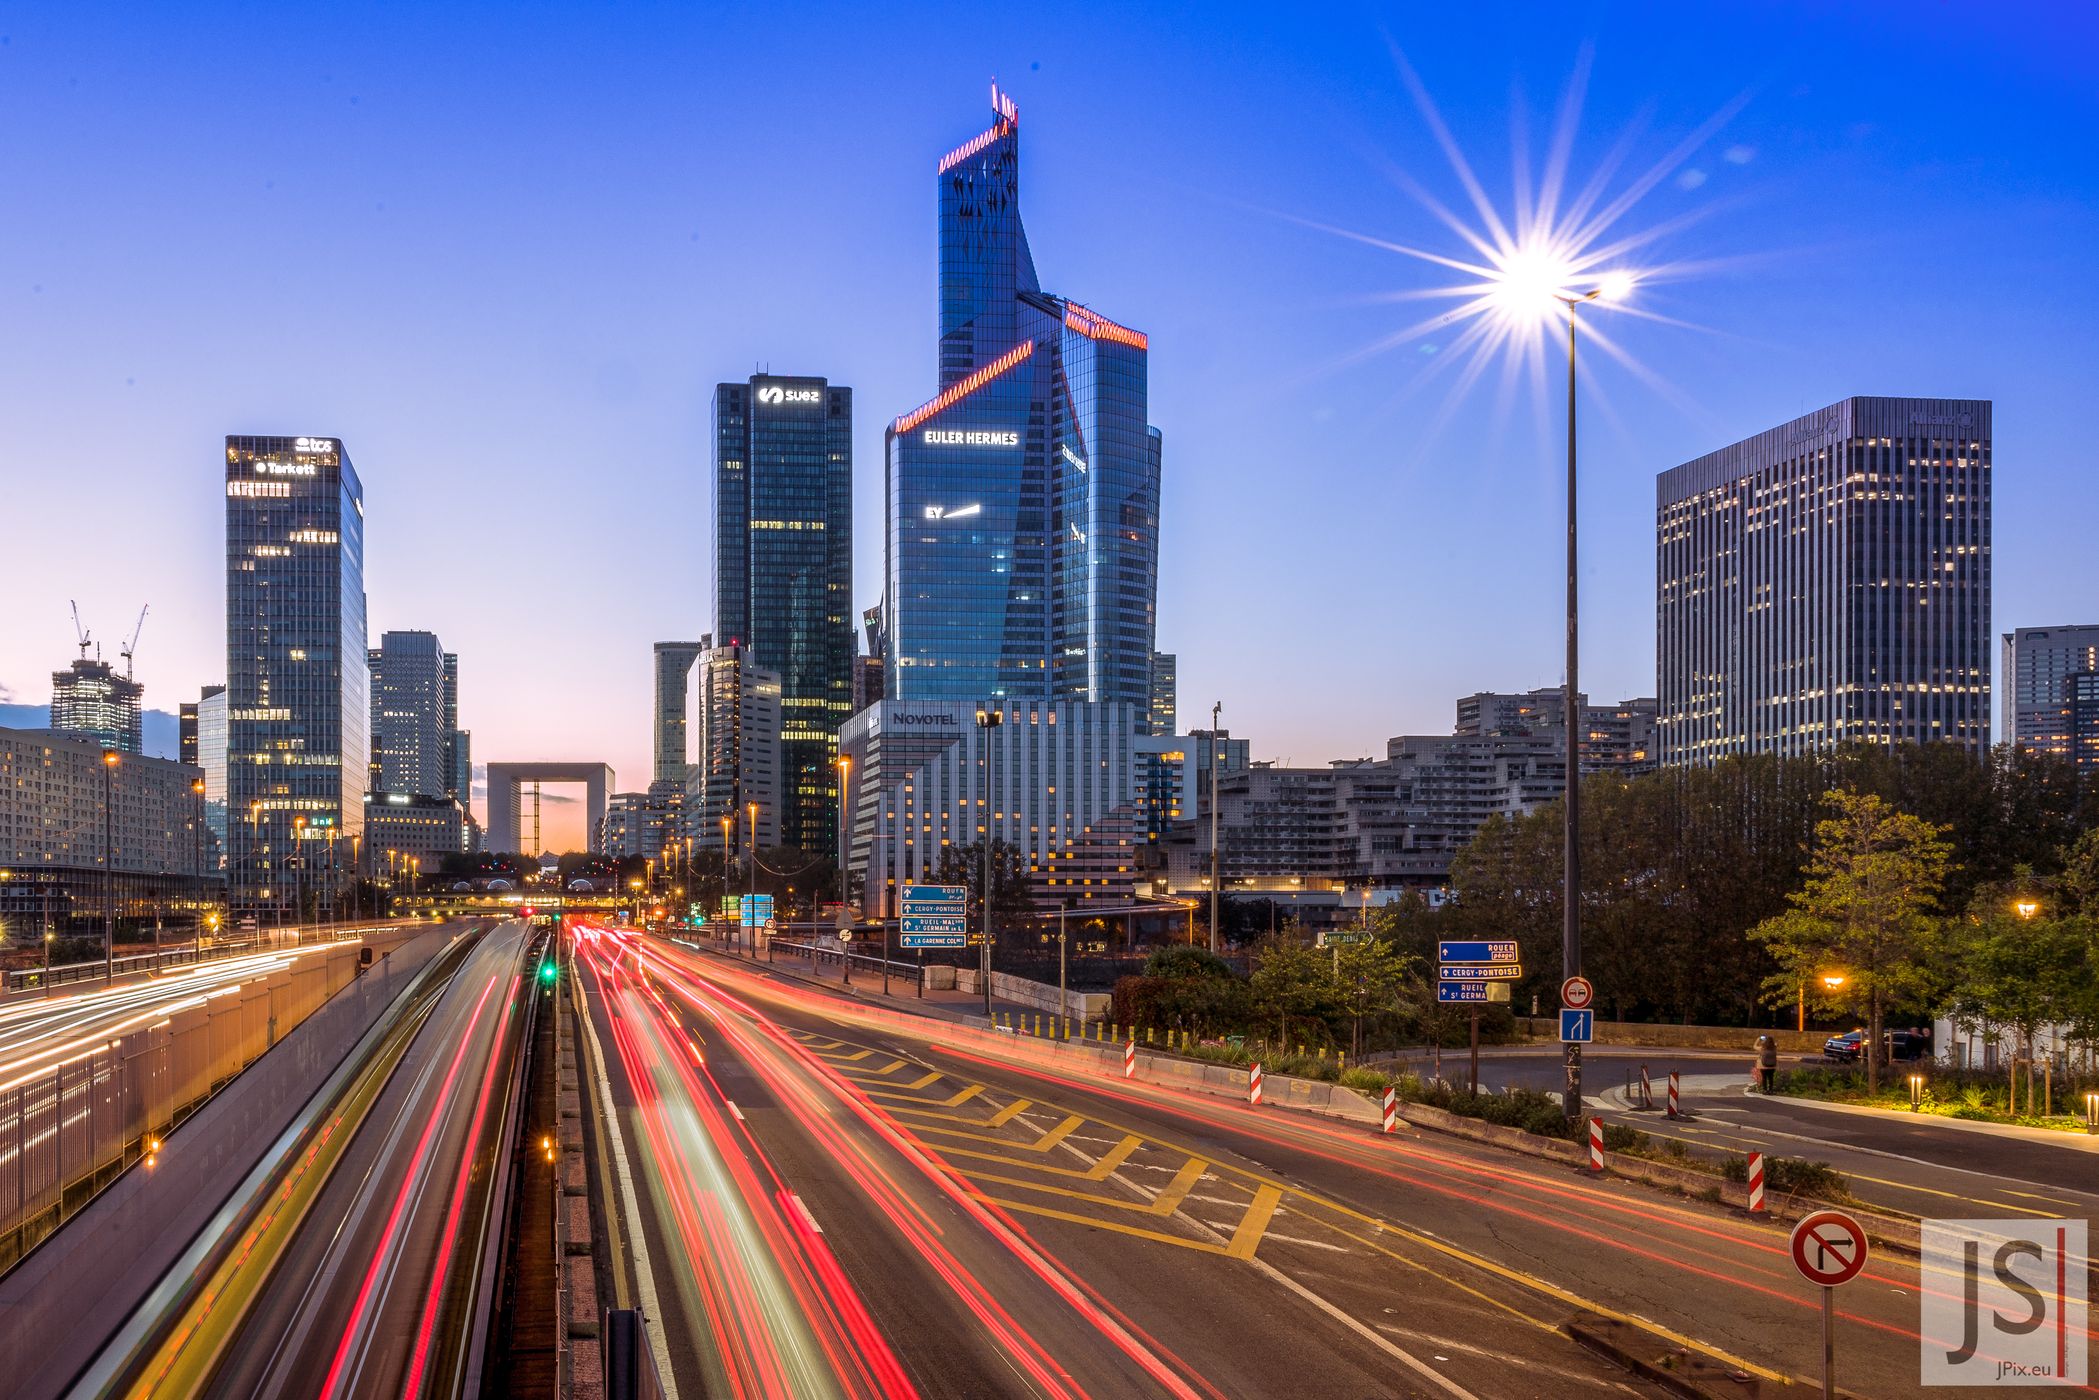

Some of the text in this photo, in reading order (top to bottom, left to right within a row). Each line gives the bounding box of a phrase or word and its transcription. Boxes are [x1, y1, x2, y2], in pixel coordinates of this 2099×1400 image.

[925, 431, 1018, 446] EULER HERMES
[925, 507, 943, 519] EY
[893, 712, 959, 725] NOVOTEL
[1452, 967, 1518, 976] CERGY-PONTOISE
